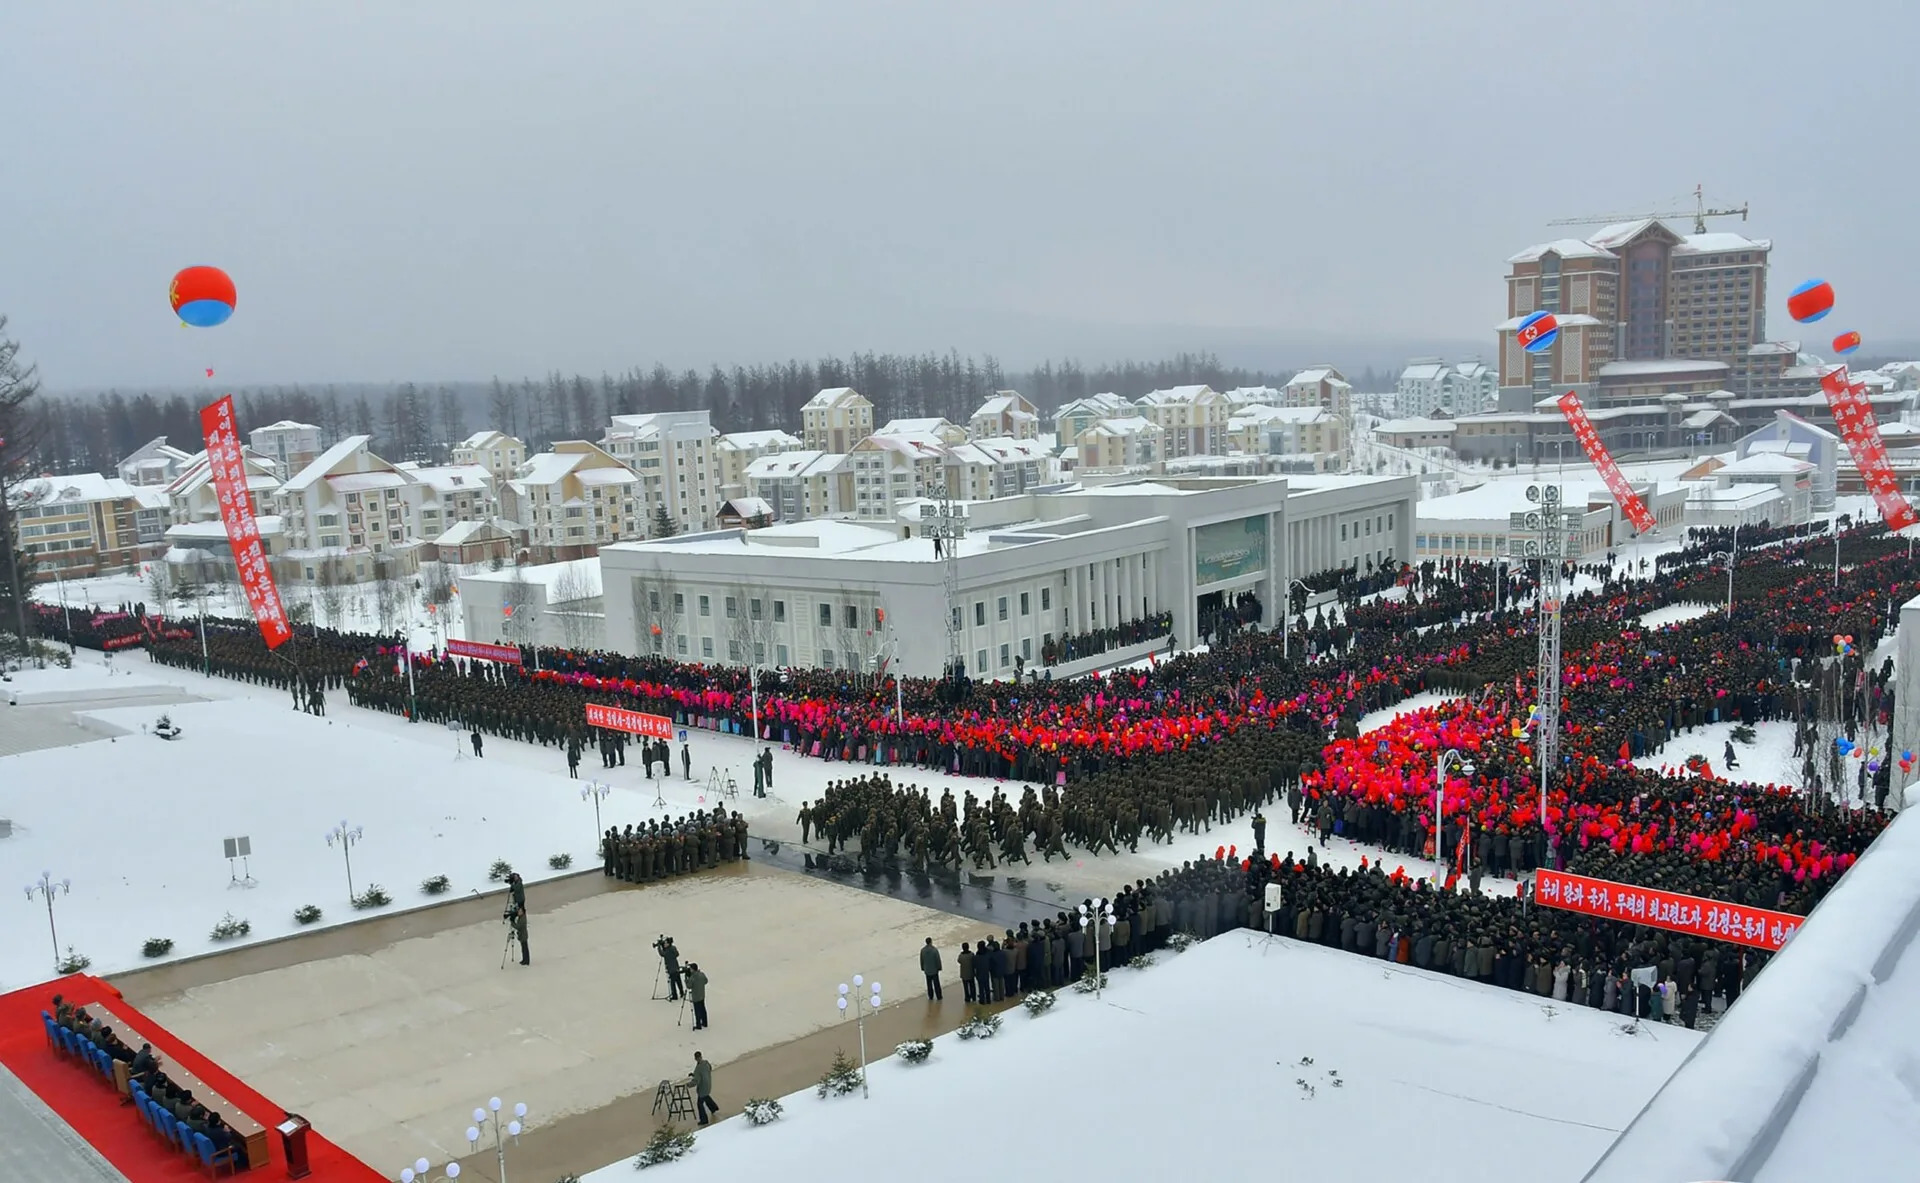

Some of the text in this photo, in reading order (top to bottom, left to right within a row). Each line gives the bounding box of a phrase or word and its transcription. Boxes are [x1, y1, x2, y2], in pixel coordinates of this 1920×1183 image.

[1566, 410, 1610, 480] 사회주의제도
[1568, 395, 1617, 473] 인민대중중심의
[1829, 395, 1864, 463] 조선로동당
[217, 401, 288, 635] 경애하는 최고령도자 김정은동지께
[222, 490, 243, 541] 영광을
[1540, 878, 1560, 903] 우리
[1563, 881, 1584, 907] 당과
[1587, 887, 1612, 912] 국가,
[1615, 893, 1645, 919] 무력의
[1648, 897, 1702, 930] 최고령도자
[1705, 906, 1766, 942] 김정은동지
